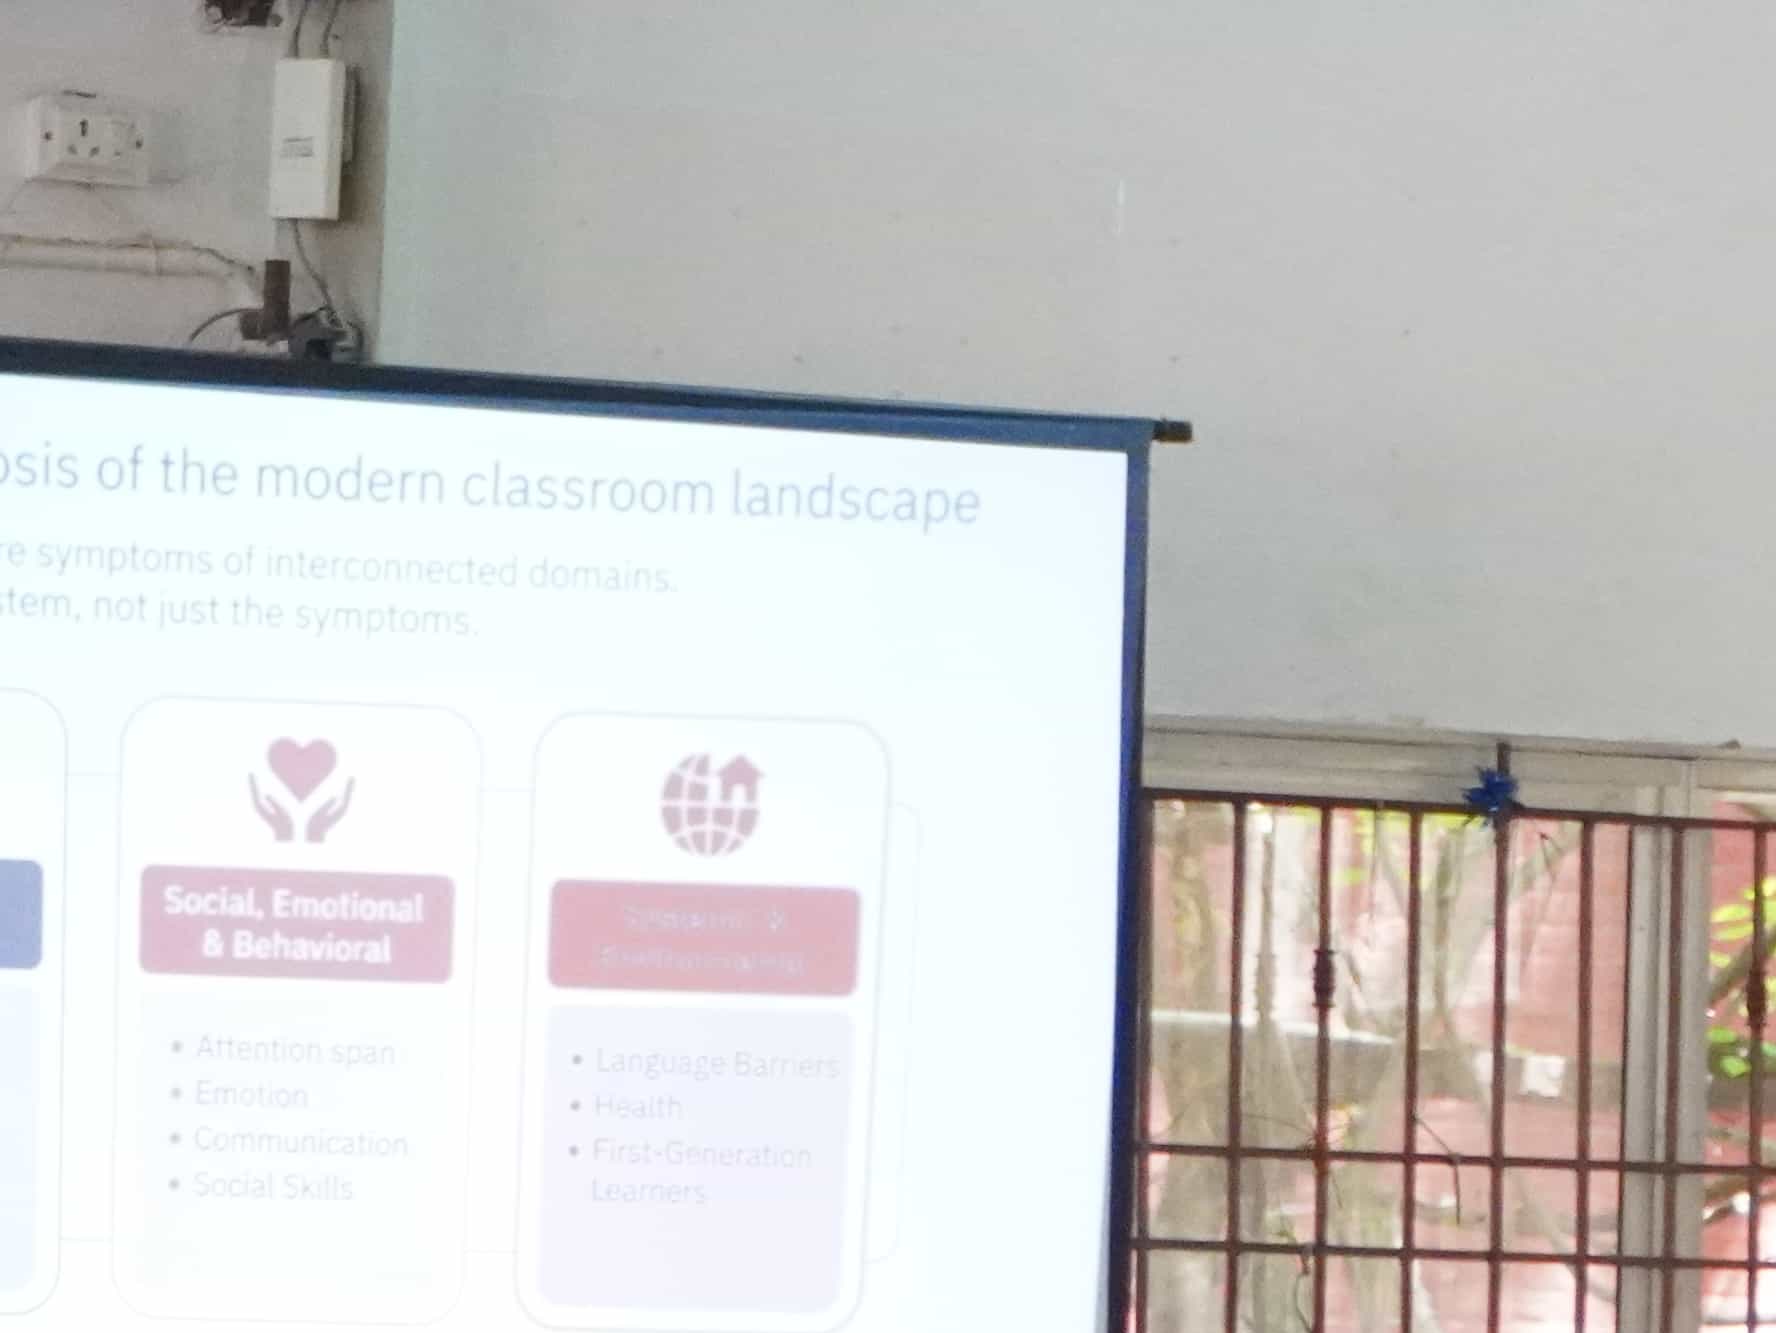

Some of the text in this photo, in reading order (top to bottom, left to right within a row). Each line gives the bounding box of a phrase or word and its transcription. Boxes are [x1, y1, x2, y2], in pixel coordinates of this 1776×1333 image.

[96, 444, 144, 492] of
[160, 449, 238, 496] the
[256, 453, 445, 504] modern
[463, 459, 716, 515] classroom
[733, 468, 980, 535] landscape
[37, 541, 213, 578] symptoms
[223, 544, 256, 576] of
[267, 545, 517, 589] interconnected
[529, 556, 678, 593] domains.
[93, 593, 148, 622] not
[157, 590, 219, 632] just
[231, 596, 284, 628] the
[296, 604, 479, 639] symptoms.
[163, 884, 424, 923] Social, Emotional
[201, 928, 391, 963] & Behavioral
[196, 1034, 395, 1071] Attention span
[596, 1047, 841, 1080] Language Barriers
[194, 1079, 310, 1108] Emotion
[594, 1095, 683, 1119] Health
[193, 1125, 409, 1156] Communication
[593, 1137, 812, 1168] First-Generation
[191, 1170, 353, 1200] Social Skills
[591, 1177, 710, 1204] Learners
